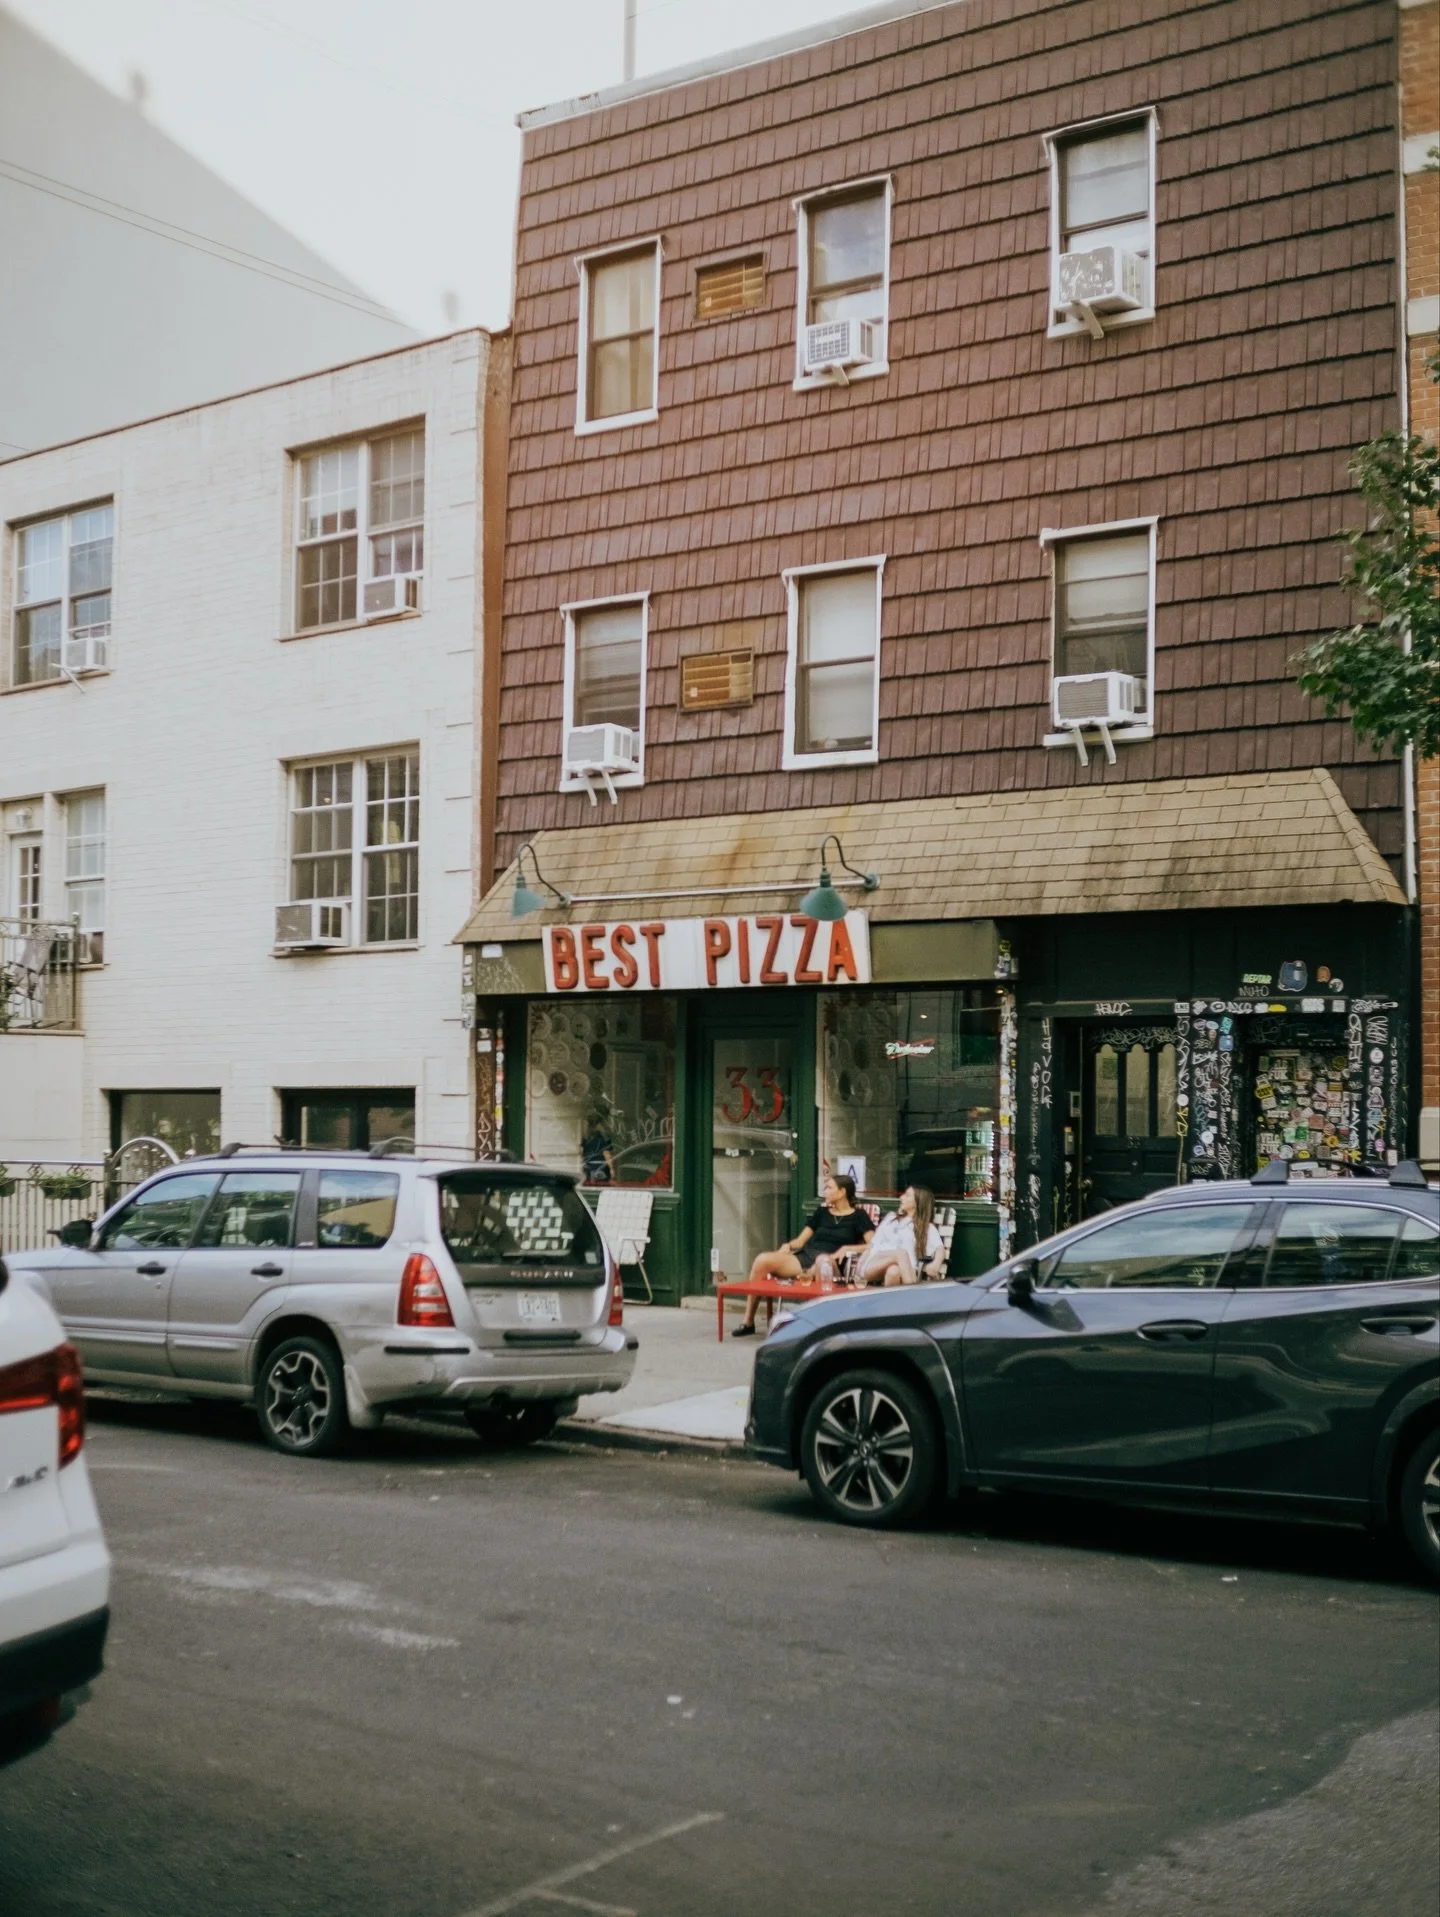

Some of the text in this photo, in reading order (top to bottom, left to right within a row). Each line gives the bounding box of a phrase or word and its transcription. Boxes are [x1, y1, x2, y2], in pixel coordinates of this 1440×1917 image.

[550, 922, 666, 990] BEST
[704, 914, 857, 987] PIZZA
[722, 1066, 784, 1124] 33
[847, 1163, 859, 1184] A
